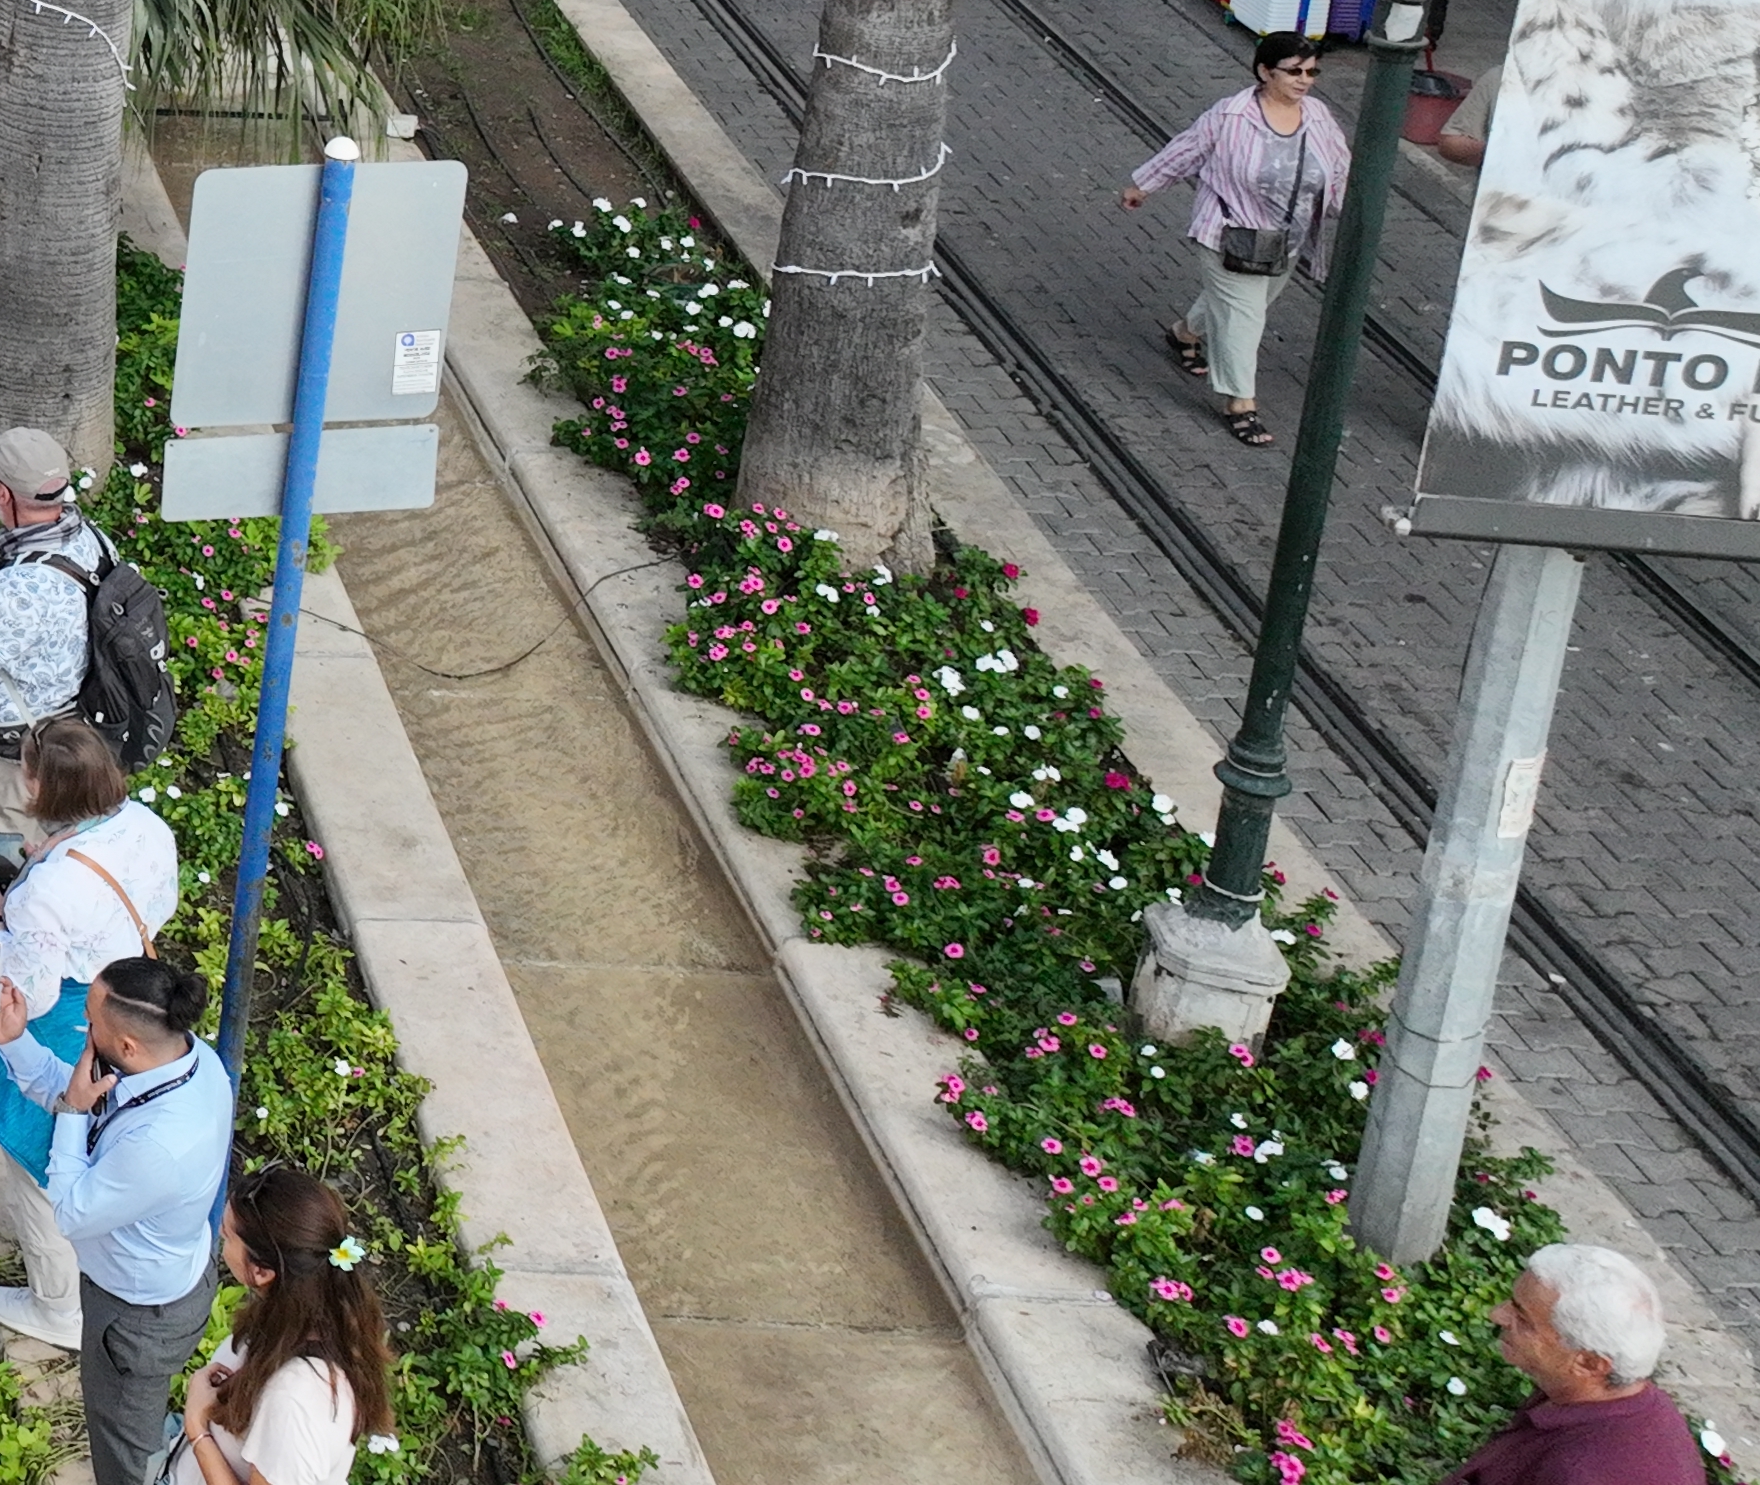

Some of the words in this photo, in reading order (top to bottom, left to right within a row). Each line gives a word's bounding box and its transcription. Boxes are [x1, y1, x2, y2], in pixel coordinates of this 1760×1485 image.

[1495, 340, 1730, 392] PONTO
[1530, 388, 1686, 418] LEATHER
[1694, 401, 1716, 421] &
